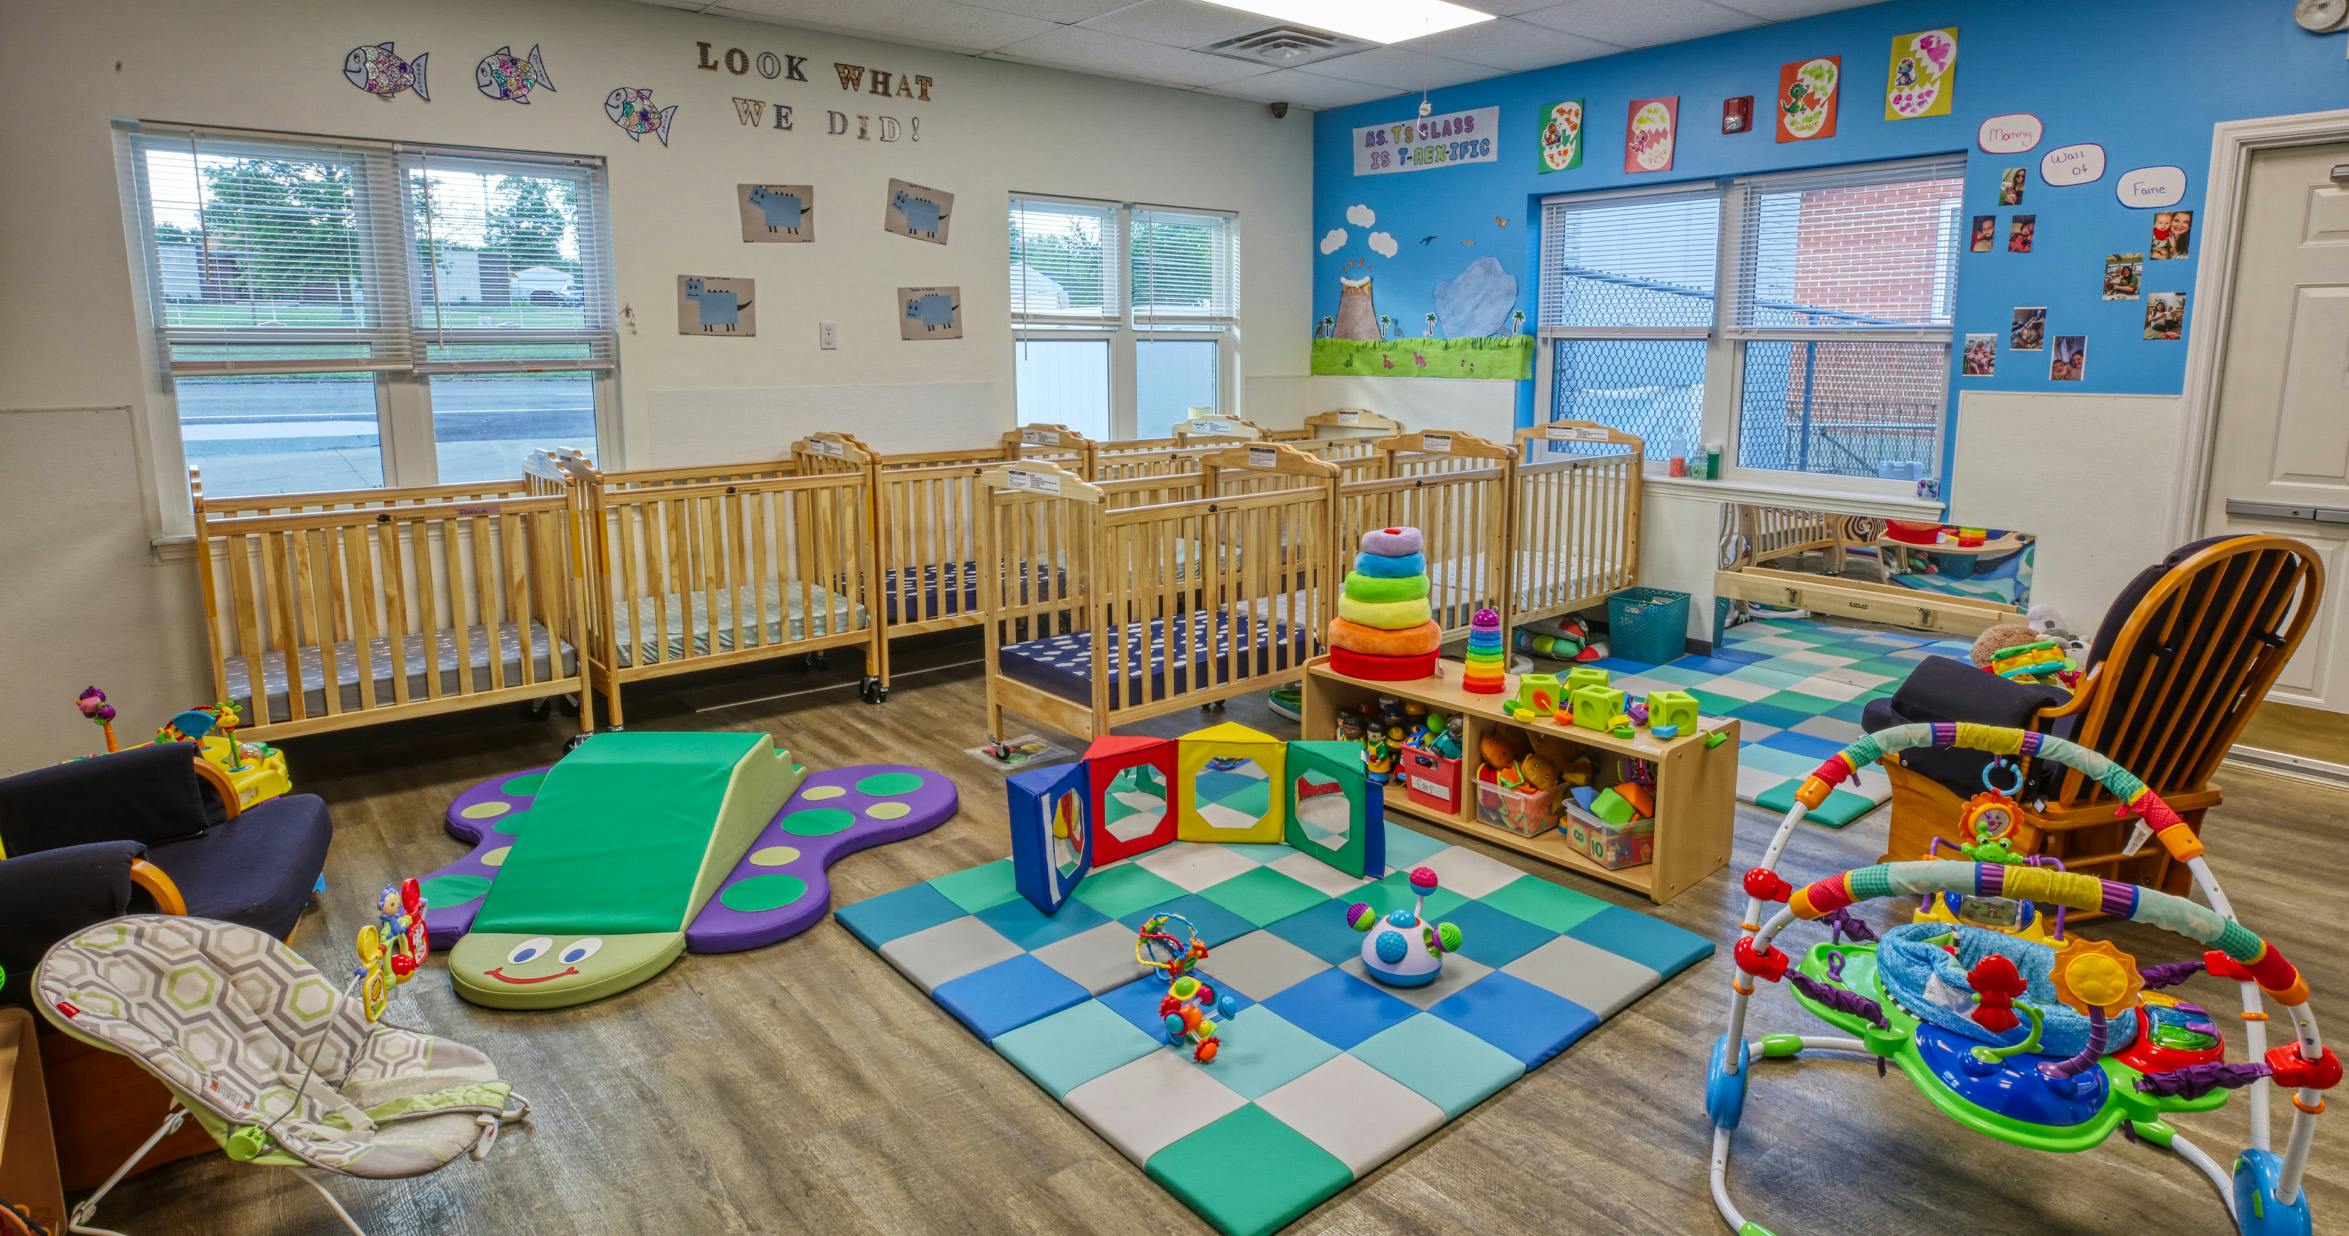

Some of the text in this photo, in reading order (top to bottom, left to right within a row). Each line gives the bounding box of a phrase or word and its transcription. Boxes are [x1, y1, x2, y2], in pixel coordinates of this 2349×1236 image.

[696, 41, 932, 101] LOOK WHAT
[732, 97, 920, 142] WE DID!
[1418, 115, 1474, 141] CLASS
[1989, 127, 2033, 147] Mommy
[1370, 151, 1391, 170] IS
[2051, 151, 2084, 164] Wall
[2133, 181, 2166, 196] Fame
[1591, 840, 1604, 858] 10
